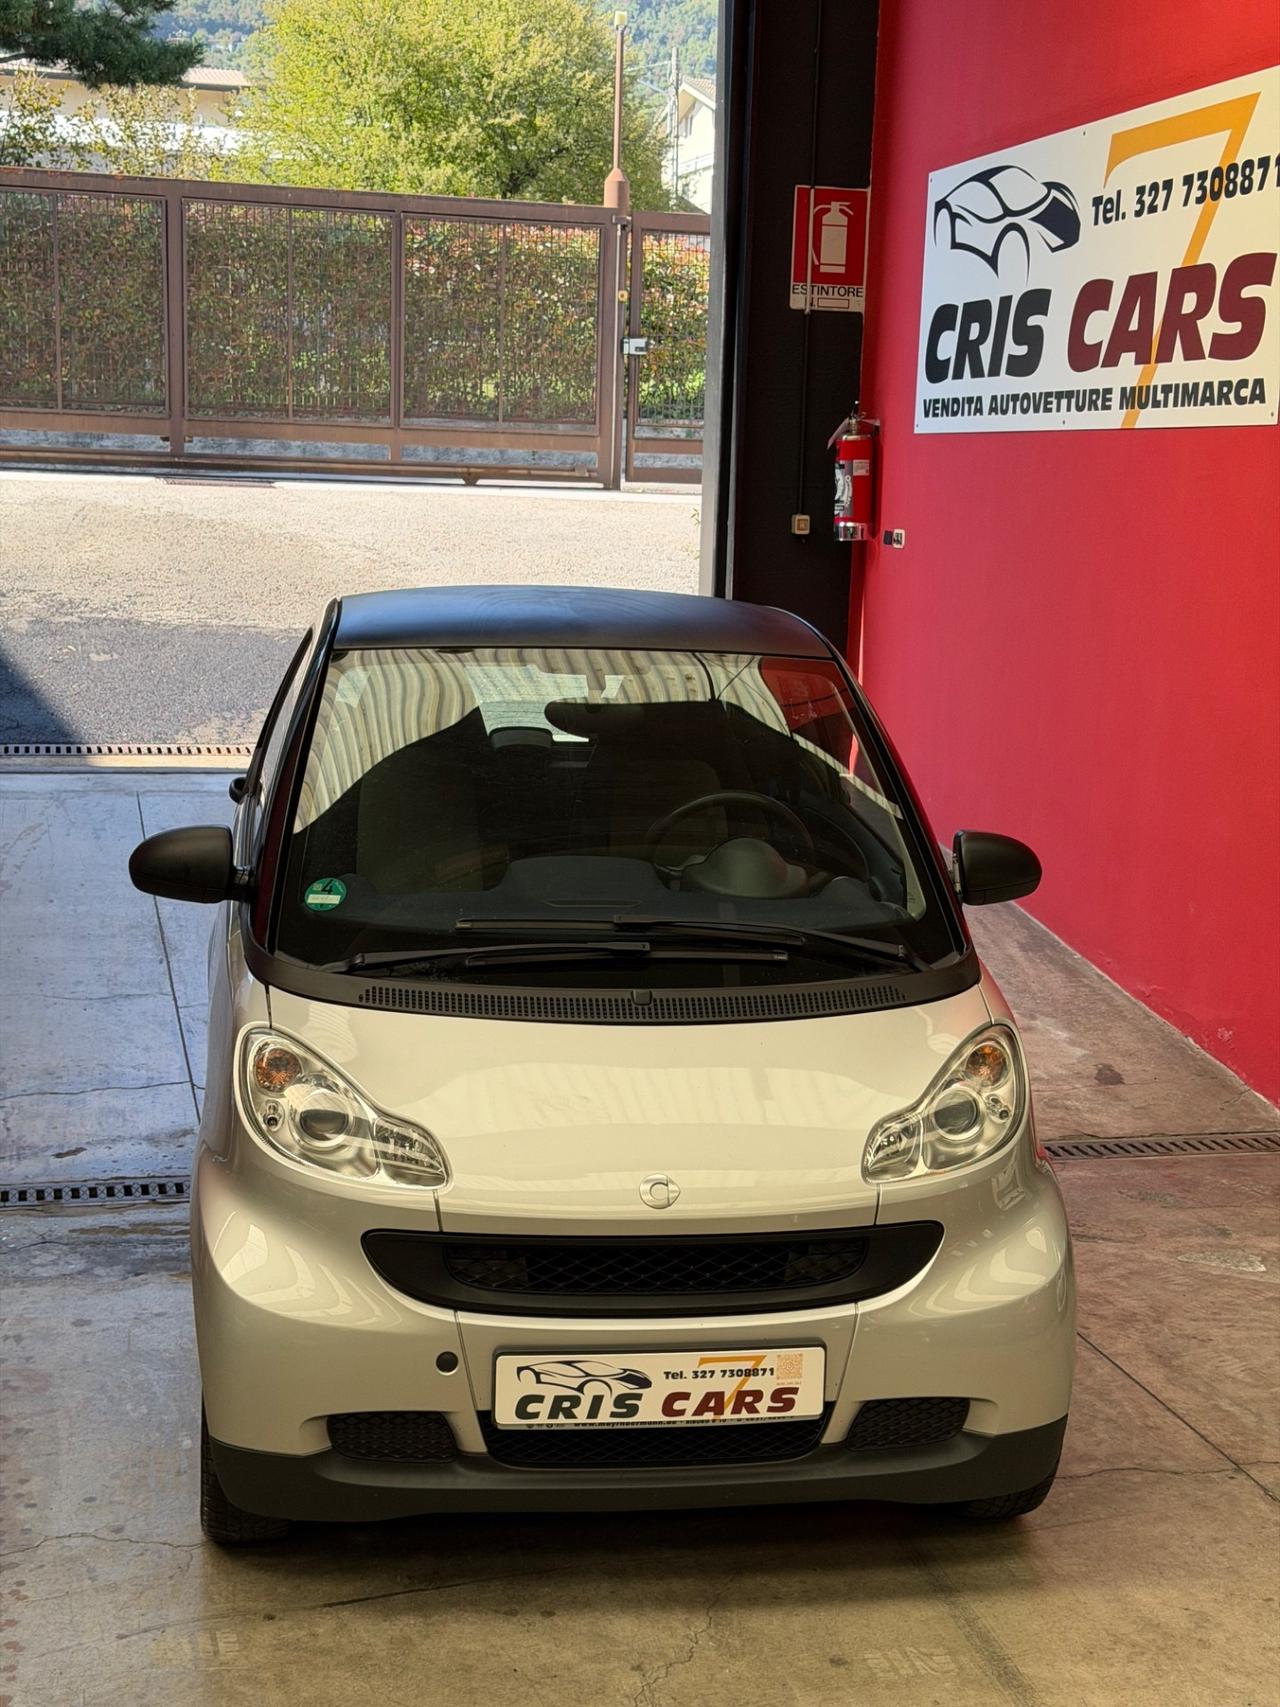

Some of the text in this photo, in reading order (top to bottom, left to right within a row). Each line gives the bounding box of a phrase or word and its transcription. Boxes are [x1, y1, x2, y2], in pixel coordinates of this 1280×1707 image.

[1092, 189, 1126, 226] Tel.
[1134, 178, 1174, 218] 327
[792, 284, 864, 297] ESTINTORE
[925, 252, 1278, 384] CRIS CARS
[923, 378, 1266, 418] VENDITA AUTOVETTURE MULTIMARCA
[321, 880, 333, 894] 4
[664, 1367, 775, 1380] Tel. 327 7308871
[514, 1387, 799, 1420] CRIS CARS
